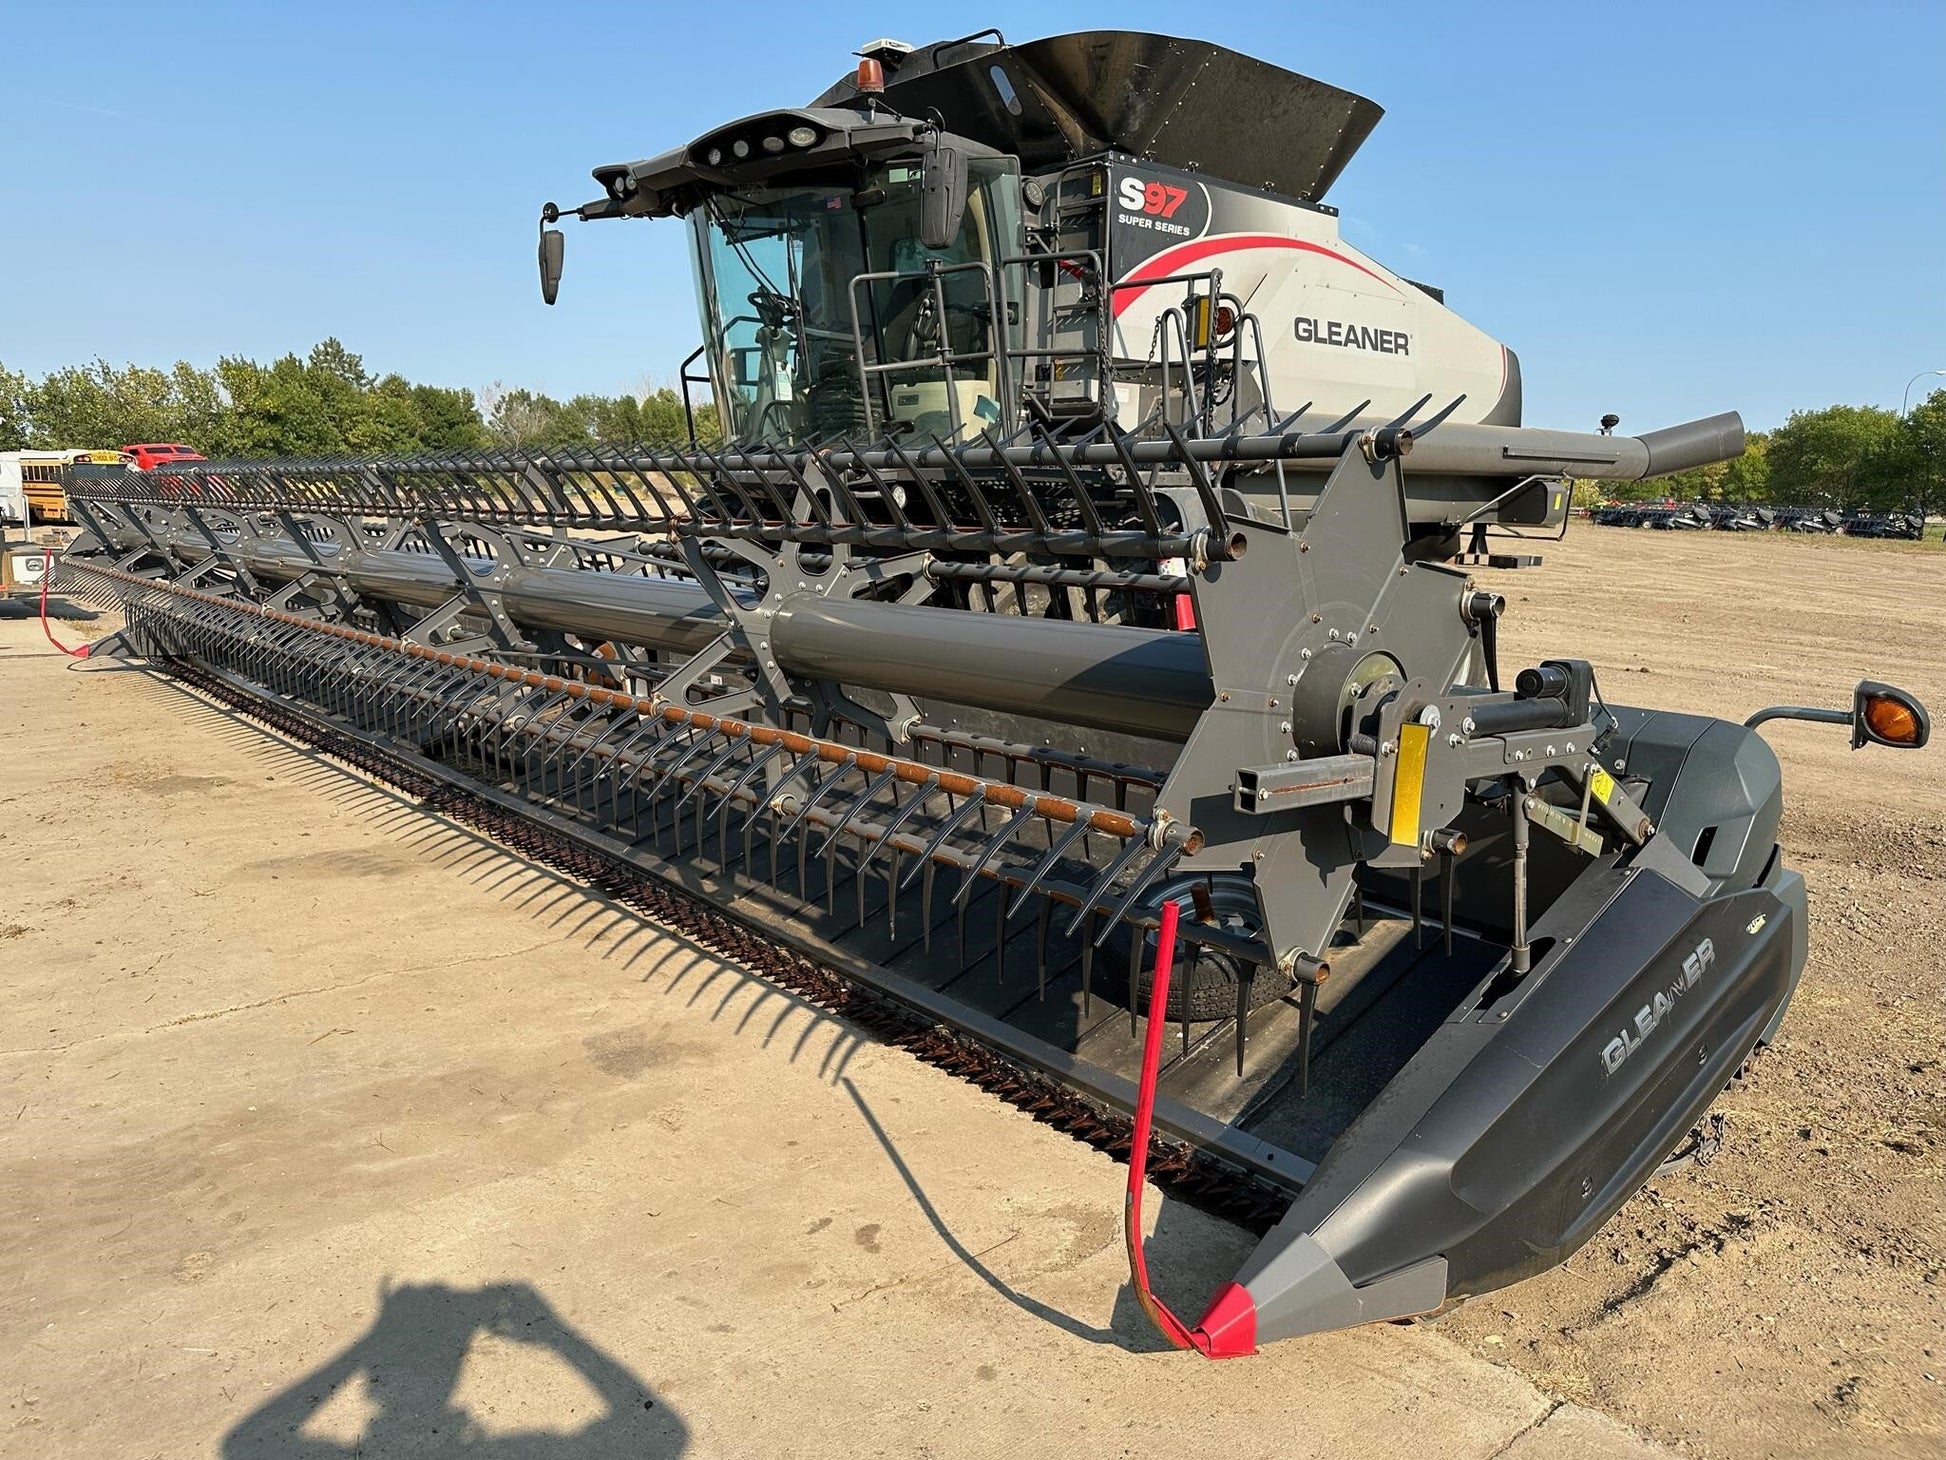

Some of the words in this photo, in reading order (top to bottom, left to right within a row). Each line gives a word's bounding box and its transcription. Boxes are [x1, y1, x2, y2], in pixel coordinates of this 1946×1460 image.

[1118, 177, 1188, 219] S97
[1118, 213, 1153, 229] SUPER
[1154, 221, 1190, 236] SERIES
[1294, 316, 1409, 356] GLEANER
